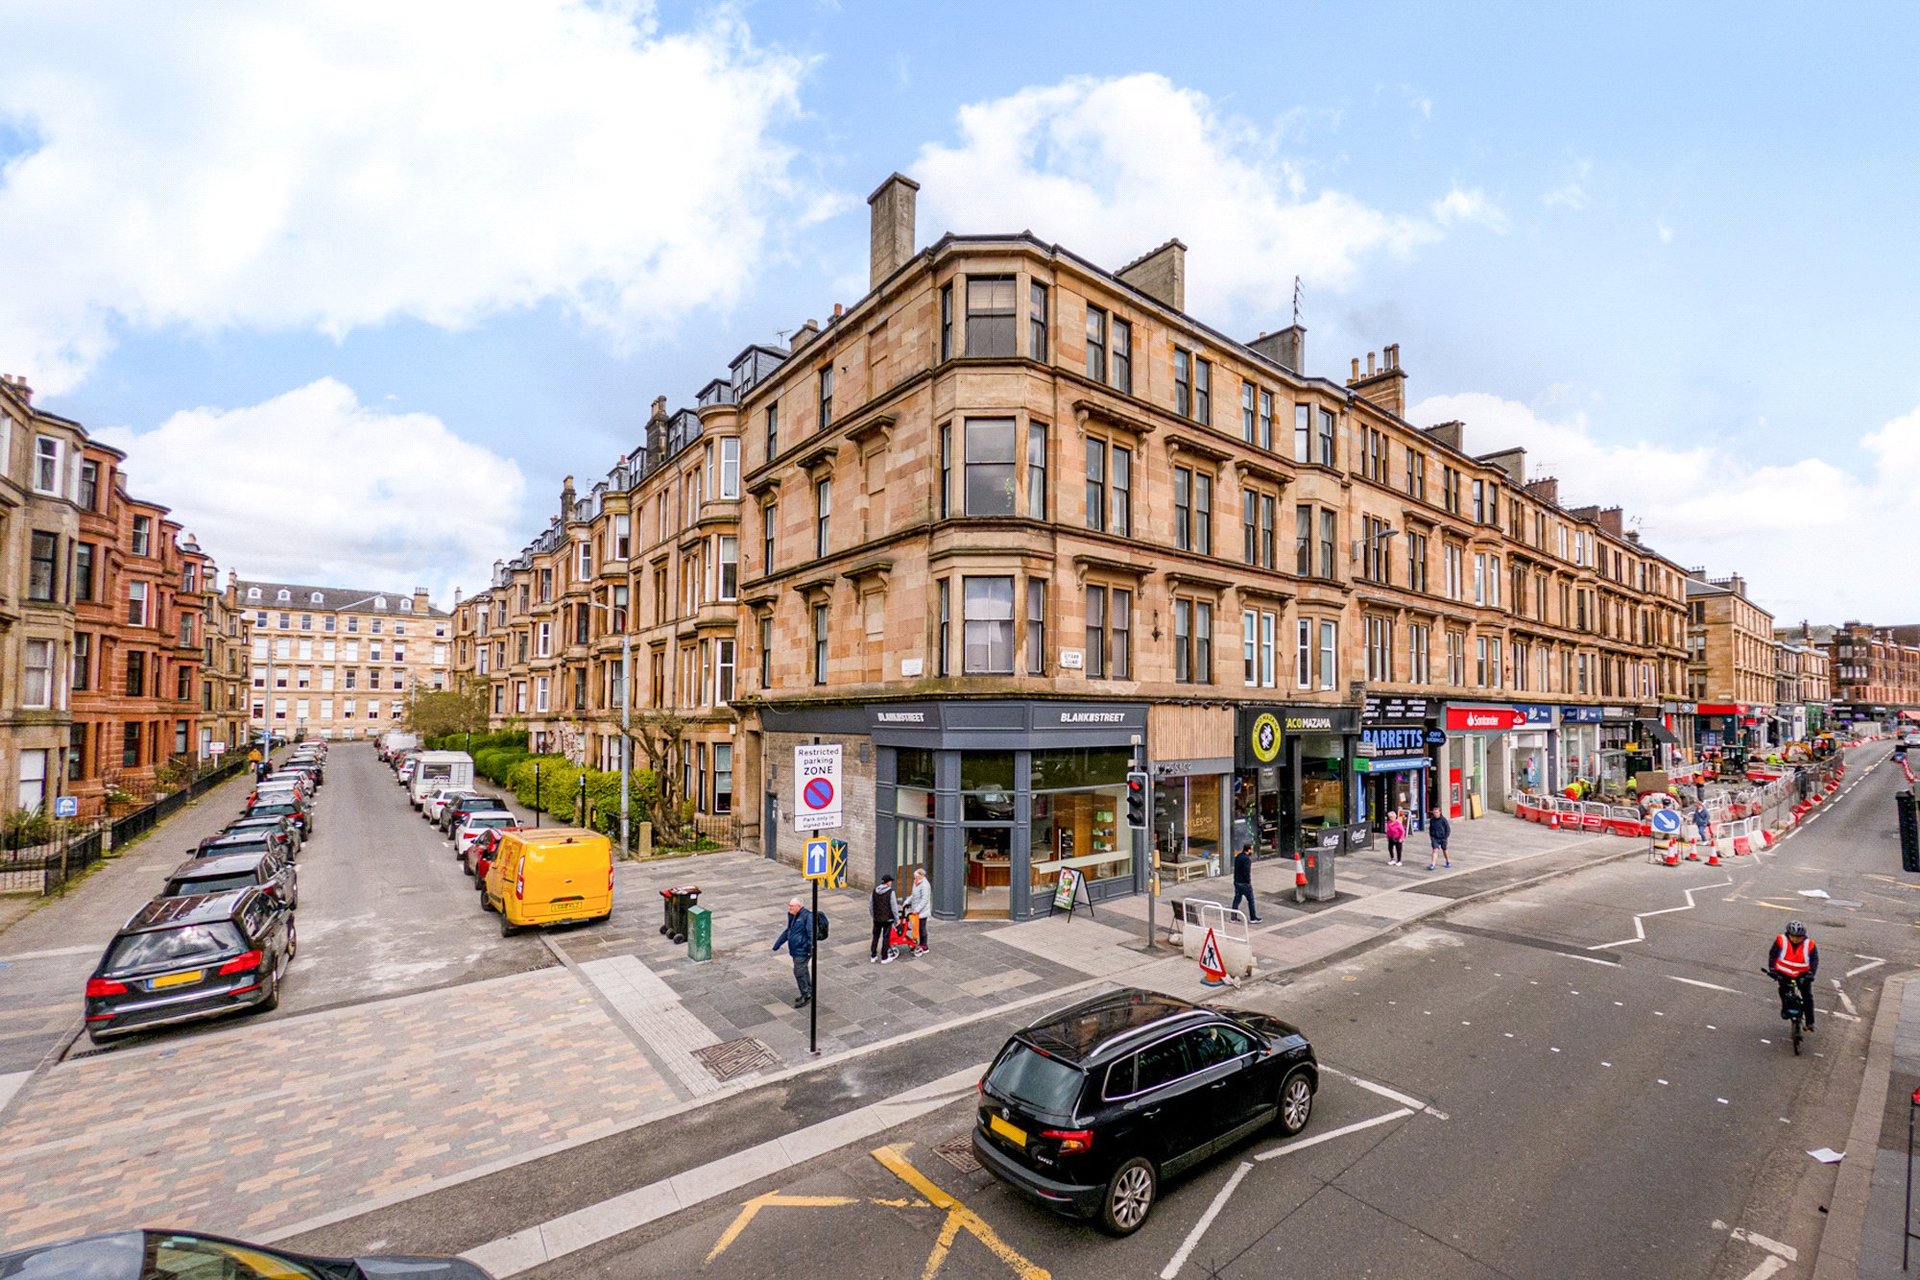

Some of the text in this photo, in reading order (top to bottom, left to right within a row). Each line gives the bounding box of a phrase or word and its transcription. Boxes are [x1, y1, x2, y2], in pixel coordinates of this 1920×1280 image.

[1060, 712, 1126, 723] BLANK STREET
[1473, 714, 1500, 726] Santander
[1363, 729, 1423, 749] BARRETTS
[798, 748, 839, 756] Restricted
[803, 757, 834, 766] parking
[803, 765, 833, 776] ZONE
